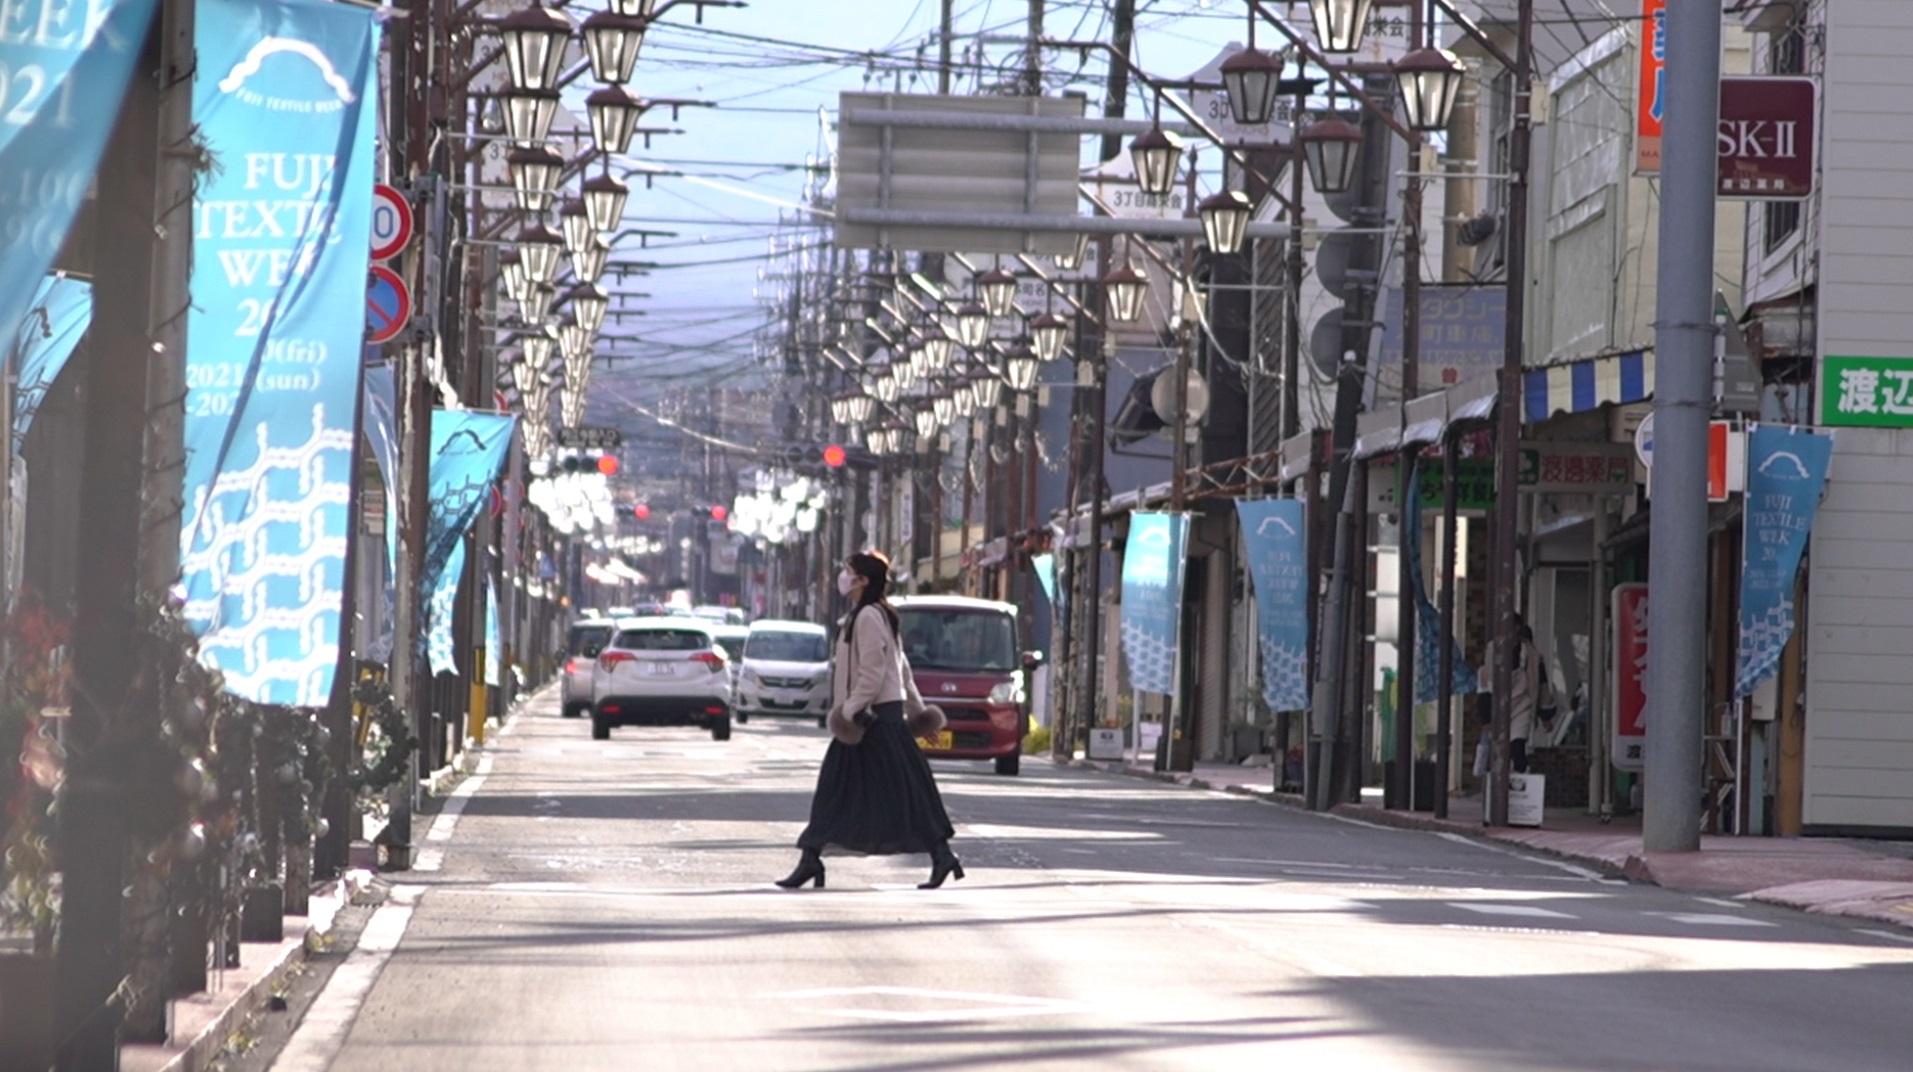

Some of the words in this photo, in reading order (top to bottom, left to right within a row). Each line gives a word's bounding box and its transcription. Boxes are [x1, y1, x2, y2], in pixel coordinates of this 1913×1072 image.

[0, 0, 130, 53] EEK
[0, 61, 76, 128] 21
[374, 205, 395, 240] 0
